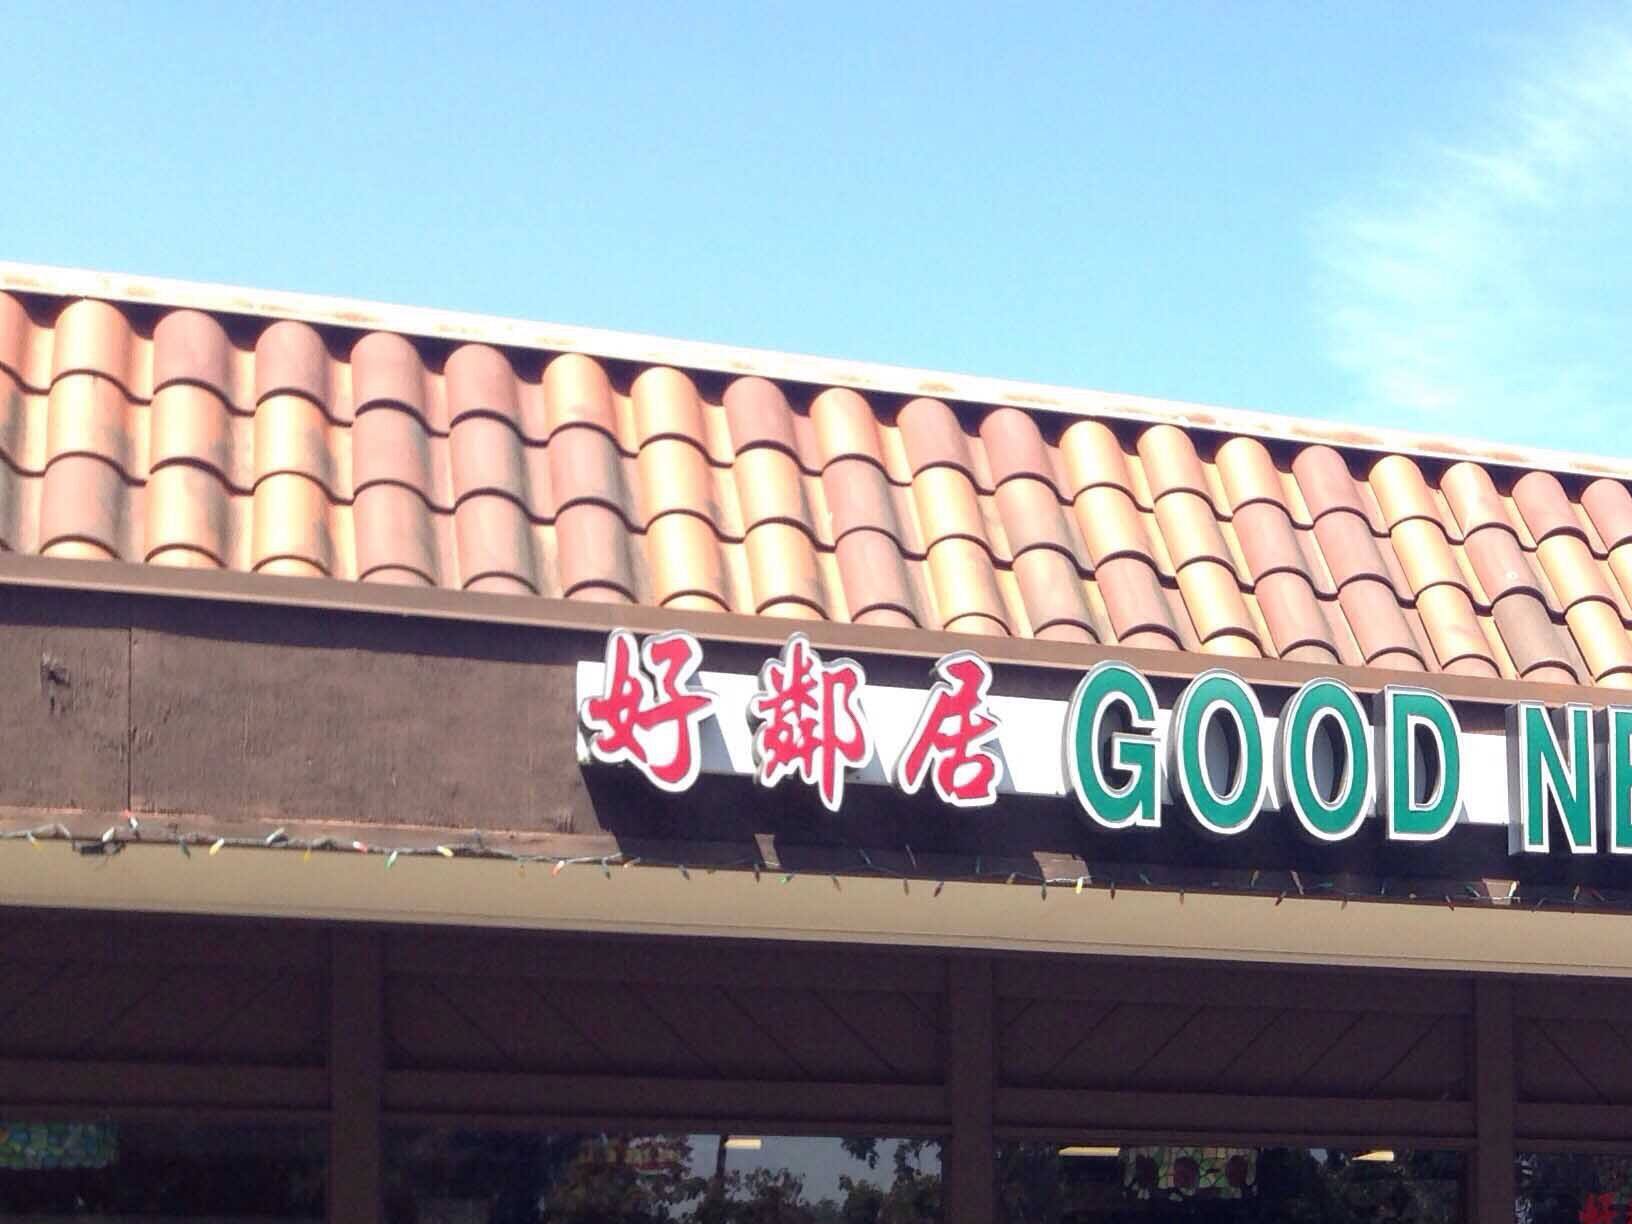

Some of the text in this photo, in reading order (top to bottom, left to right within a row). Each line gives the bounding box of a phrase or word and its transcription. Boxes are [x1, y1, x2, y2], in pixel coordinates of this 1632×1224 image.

[583, 628, 1001, 811] 好鄰居
[1063, 660, 1463, 841] GOOD
